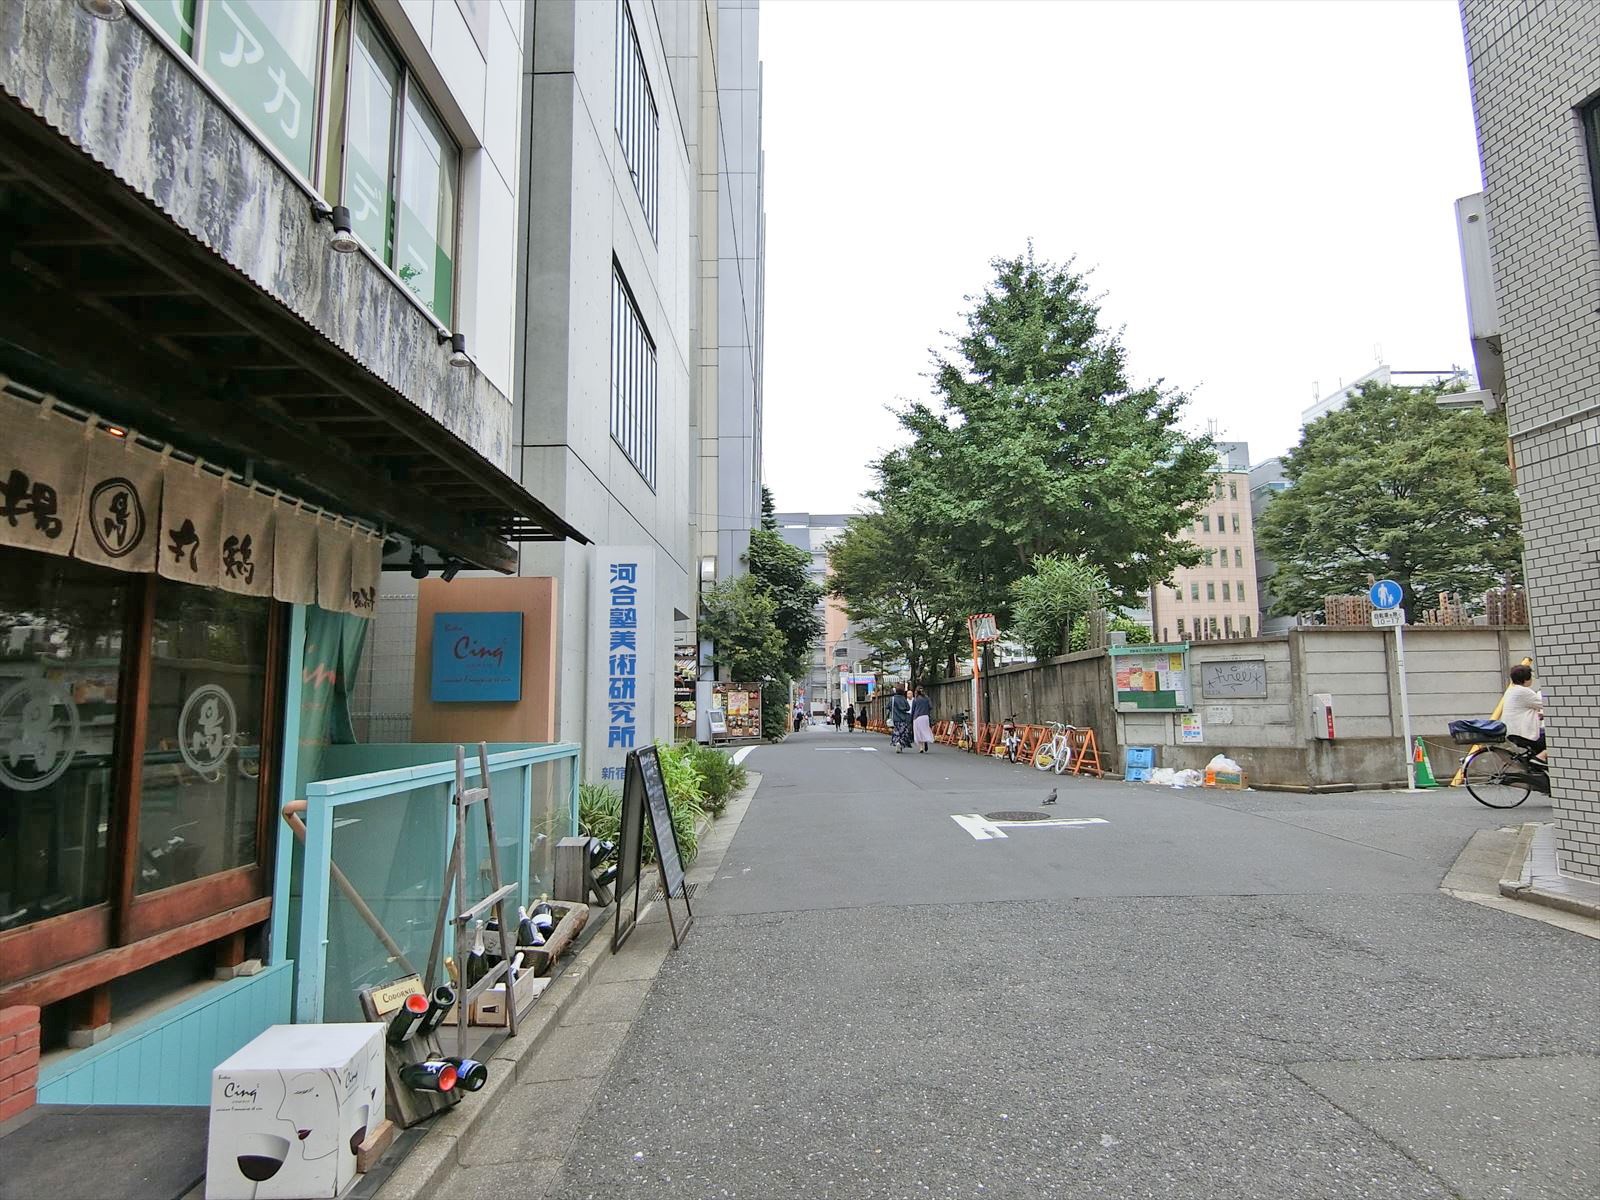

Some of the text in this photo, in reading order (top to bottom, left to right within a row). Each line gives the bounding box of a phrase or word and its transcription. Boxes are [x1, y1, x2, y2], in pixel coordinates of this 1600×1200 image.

[608, 563, 638, 748] 河合塾美術研究所
[224, 1081, 257, 1104] Cinq
